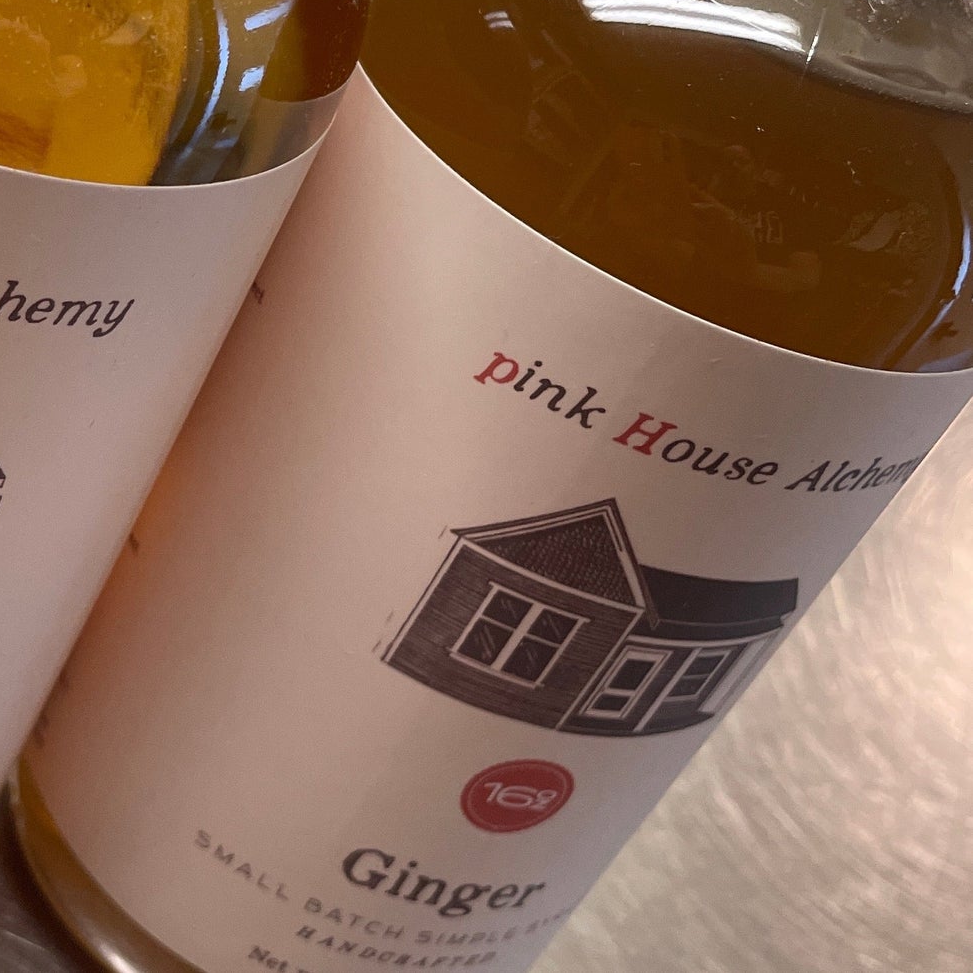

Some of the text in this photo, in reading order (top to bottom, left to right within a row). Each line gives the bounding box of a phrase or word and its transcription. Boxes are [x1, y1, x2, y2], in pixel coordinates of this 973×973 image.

[473, 351, 606, 429] pink
[613, 411, 779, 486] House
[195, 829, 289, 901] SMALL
[304, 897, 405, 940] BATCH
[342, 848, 546, 918] Ginger
